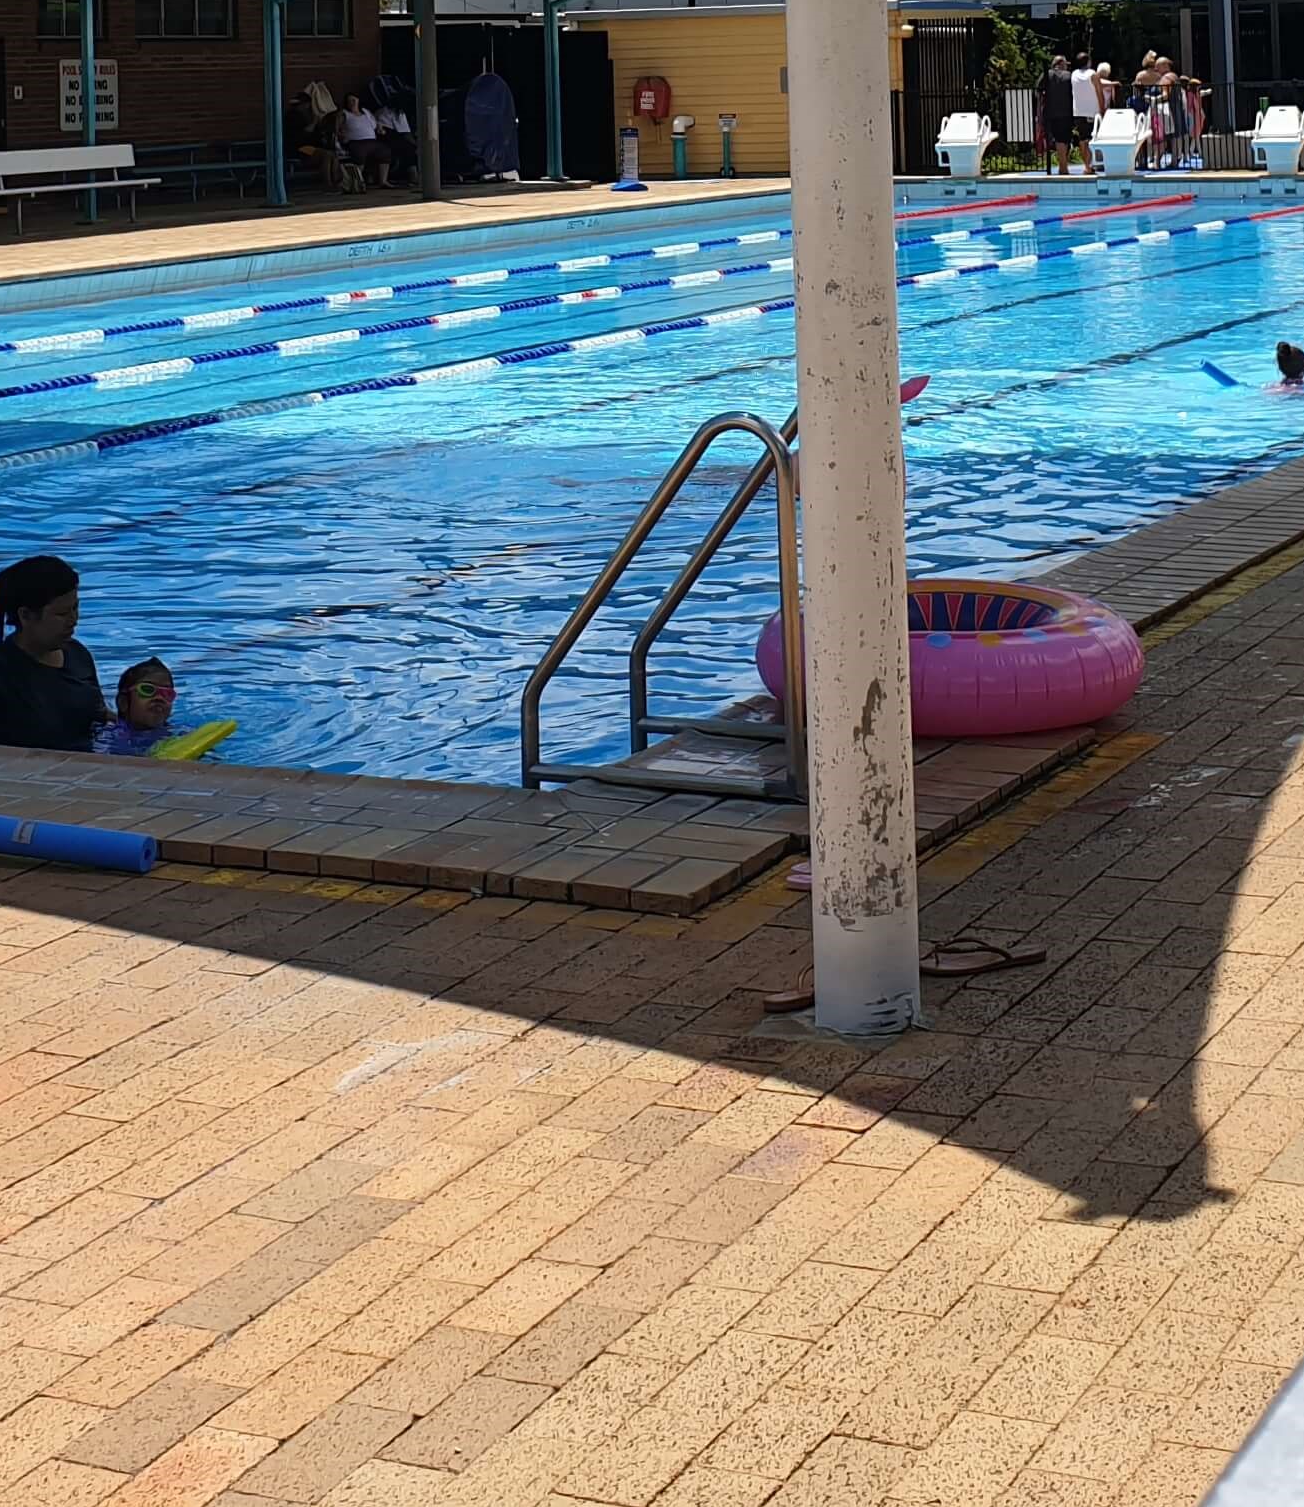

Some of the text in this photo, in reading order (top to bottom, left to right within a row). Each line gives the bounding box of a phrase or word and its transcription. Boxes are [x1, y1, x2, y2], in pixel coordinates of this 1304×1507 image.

[68, 80, 80, 91] NO
[65, 95, 76, 106] NO
[65, 112, 76, 124] NO
